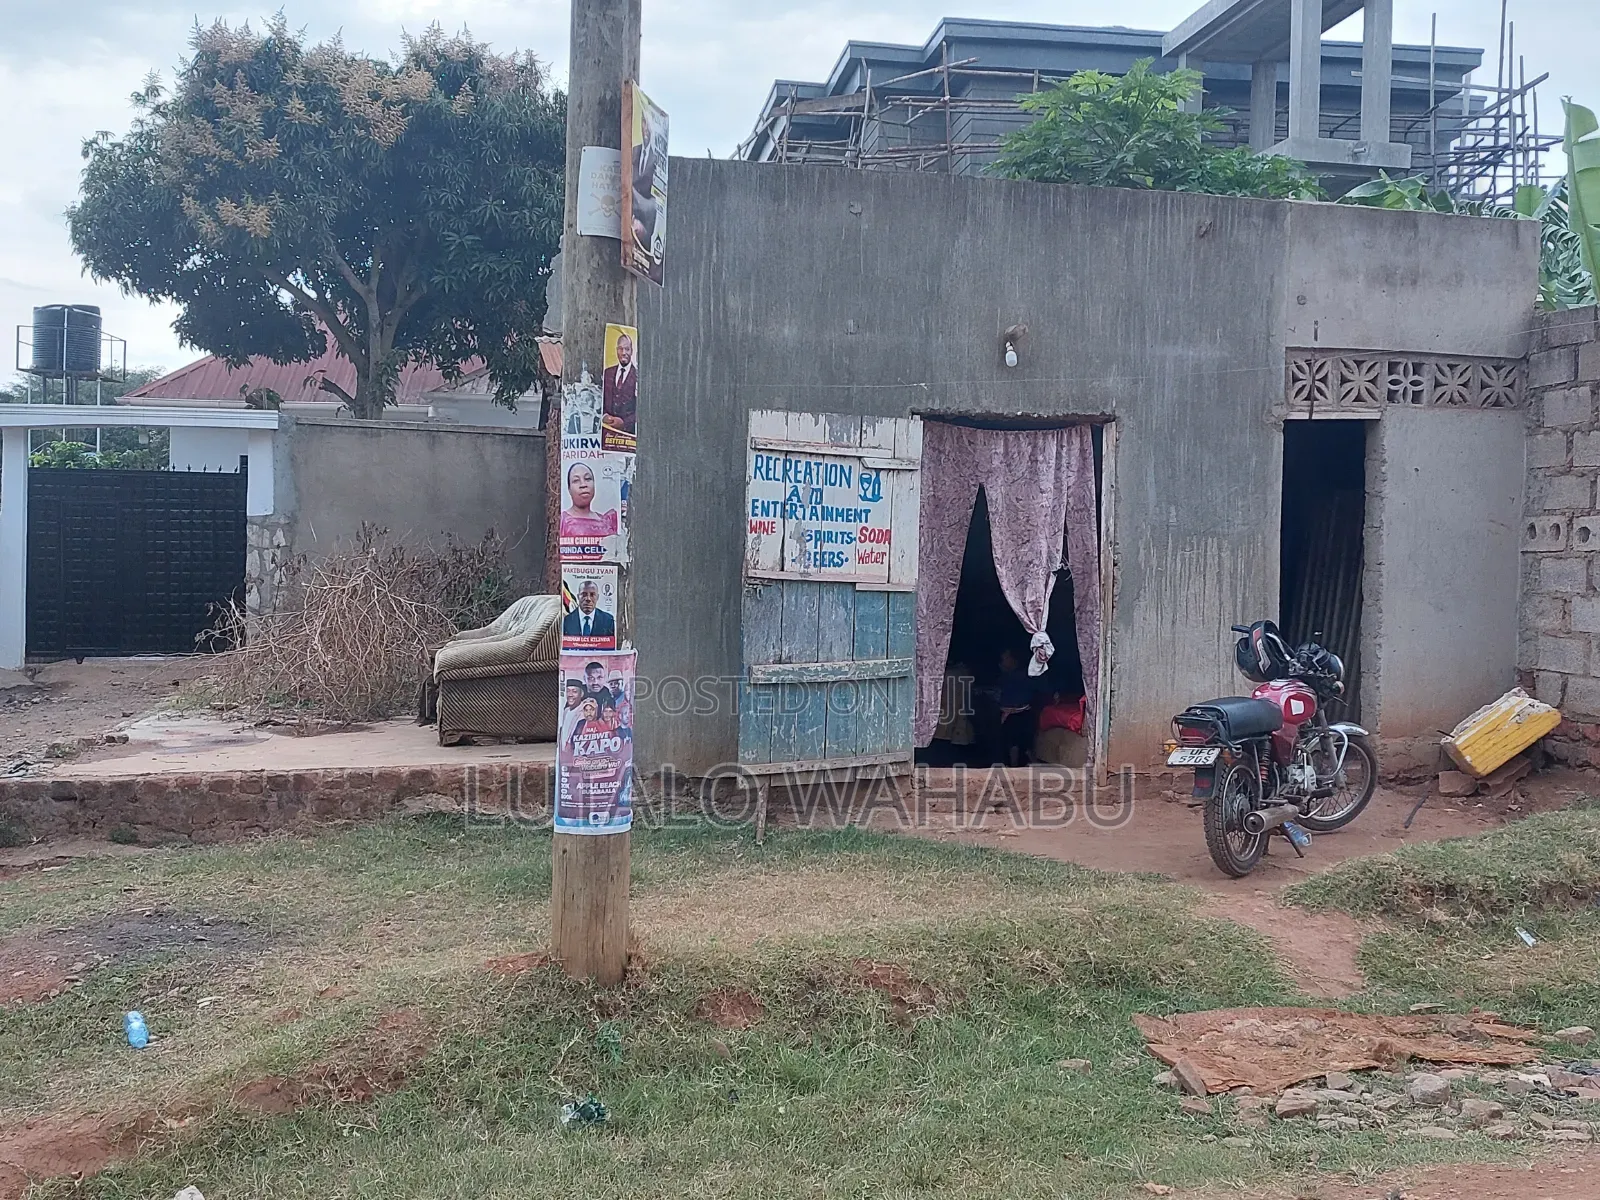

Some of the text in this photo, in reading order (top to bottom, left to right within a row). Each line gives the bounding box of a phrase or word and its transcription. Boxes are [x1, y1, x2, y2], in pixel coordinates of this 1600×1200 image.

[753, 454, 853, 489] RECREATION
[751, 499, 871, 523] ENTERTAINMENT
[749, 520, 776, 536] WINE
[858, 526, 891, 545] SODA
[857, 549, 887, 565] Water
[573, 732, 609, 741] KAZIBWE
[573, 736, 621, 757] KAPO
